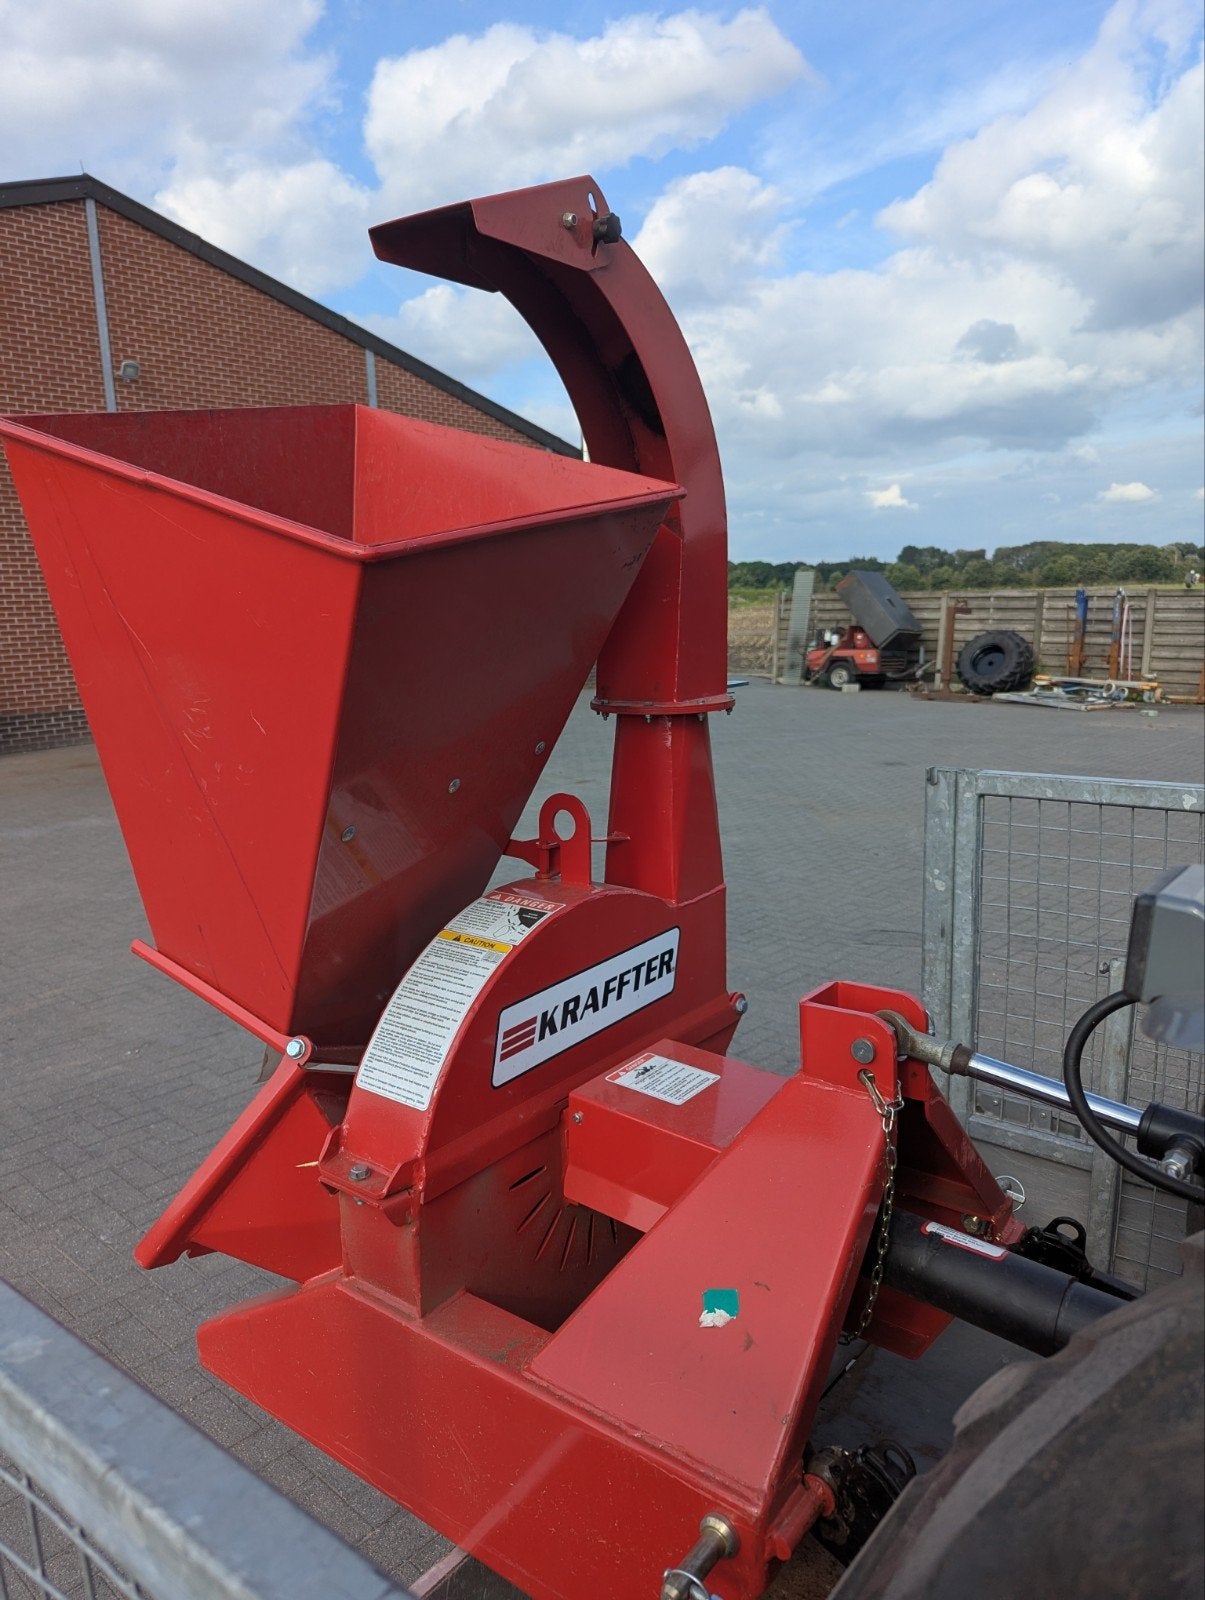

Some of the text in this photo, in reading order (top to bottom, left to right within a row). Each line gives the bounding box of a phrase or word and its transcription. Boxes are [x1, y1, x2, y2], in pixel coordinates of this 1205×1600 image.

[504, 895, 556, 911] DANGER
[463, 937, 497, 949] CAUTION
[538, 948, 674, 1042] KRAFFTER
